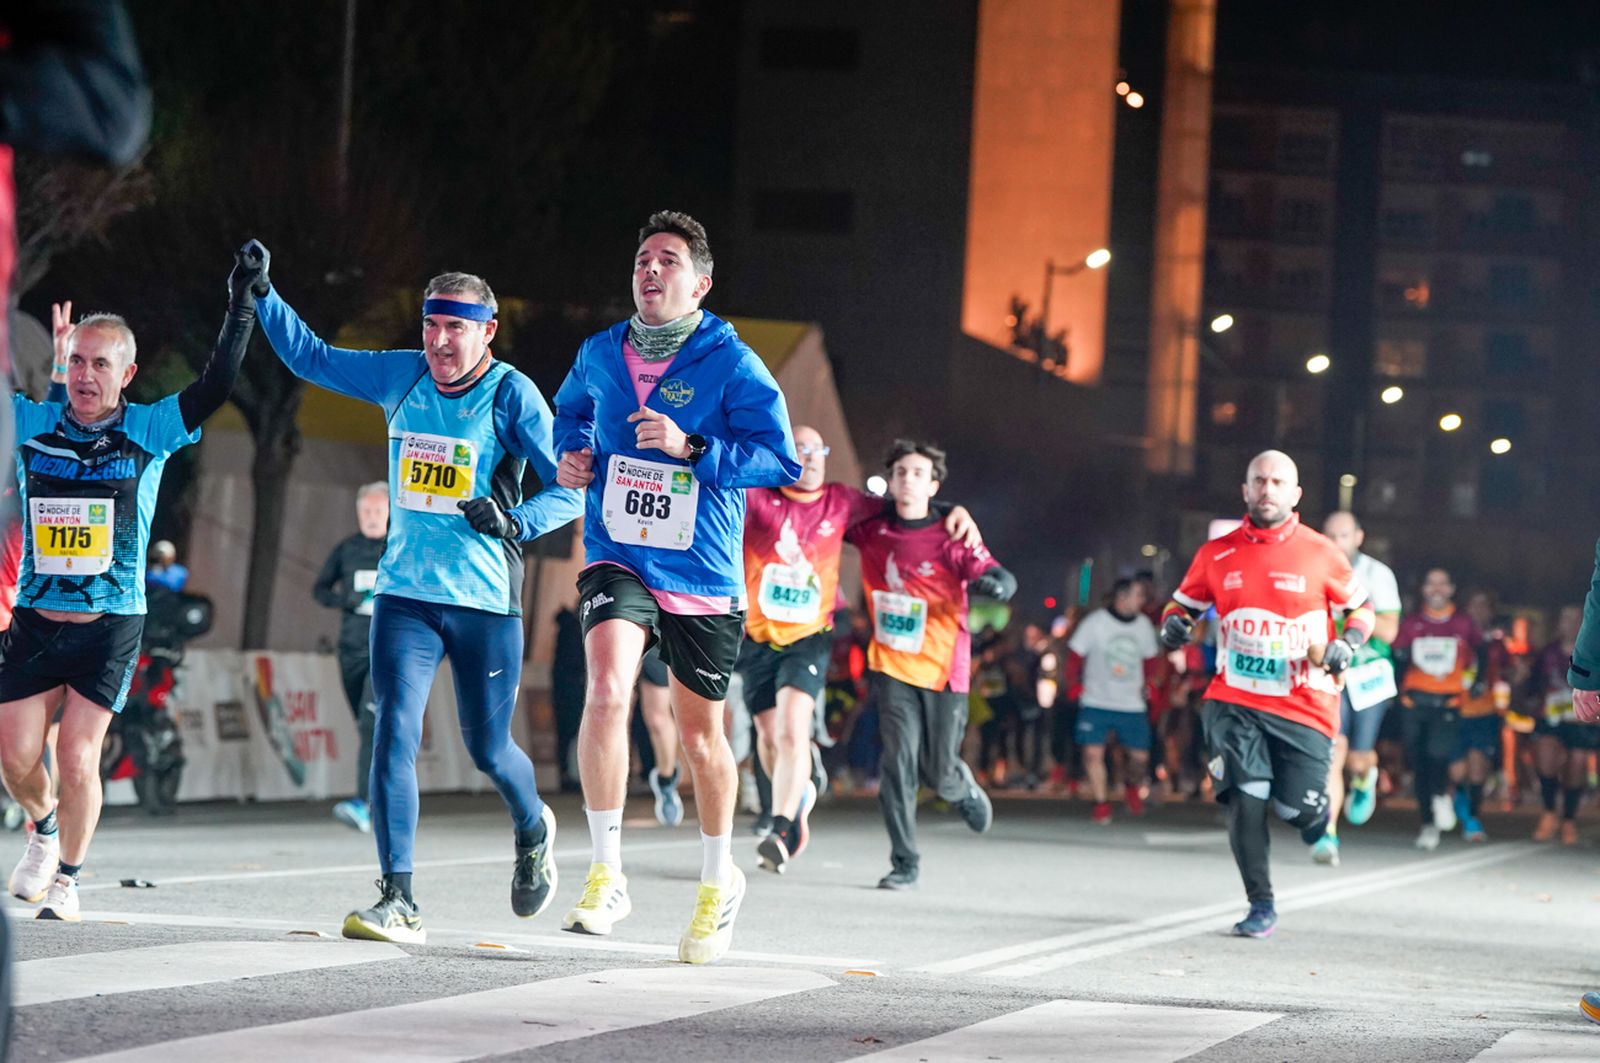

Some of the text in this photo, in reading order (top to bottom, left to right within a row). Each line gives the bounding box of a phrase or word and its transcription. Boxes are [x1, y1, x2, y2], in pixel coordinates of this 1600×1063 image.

[406, 450, 419, 459] SAN
[415, 442, 436, 451] NOCHE
[30, 453, 79, 480] MEDIA
[411, 461, 456, 489] 5710
[627, 469, 665, 481] NOCHE DE
[616, 476, 632, 487] SAN
[633, 478, 663, 492] ANTÓN
[625, 490, 672, 520] 683
[39, 516, 53, 524] SAN
[48, 526, 92, 549] 7175
[1235, 651, 1277, 675] 8224
